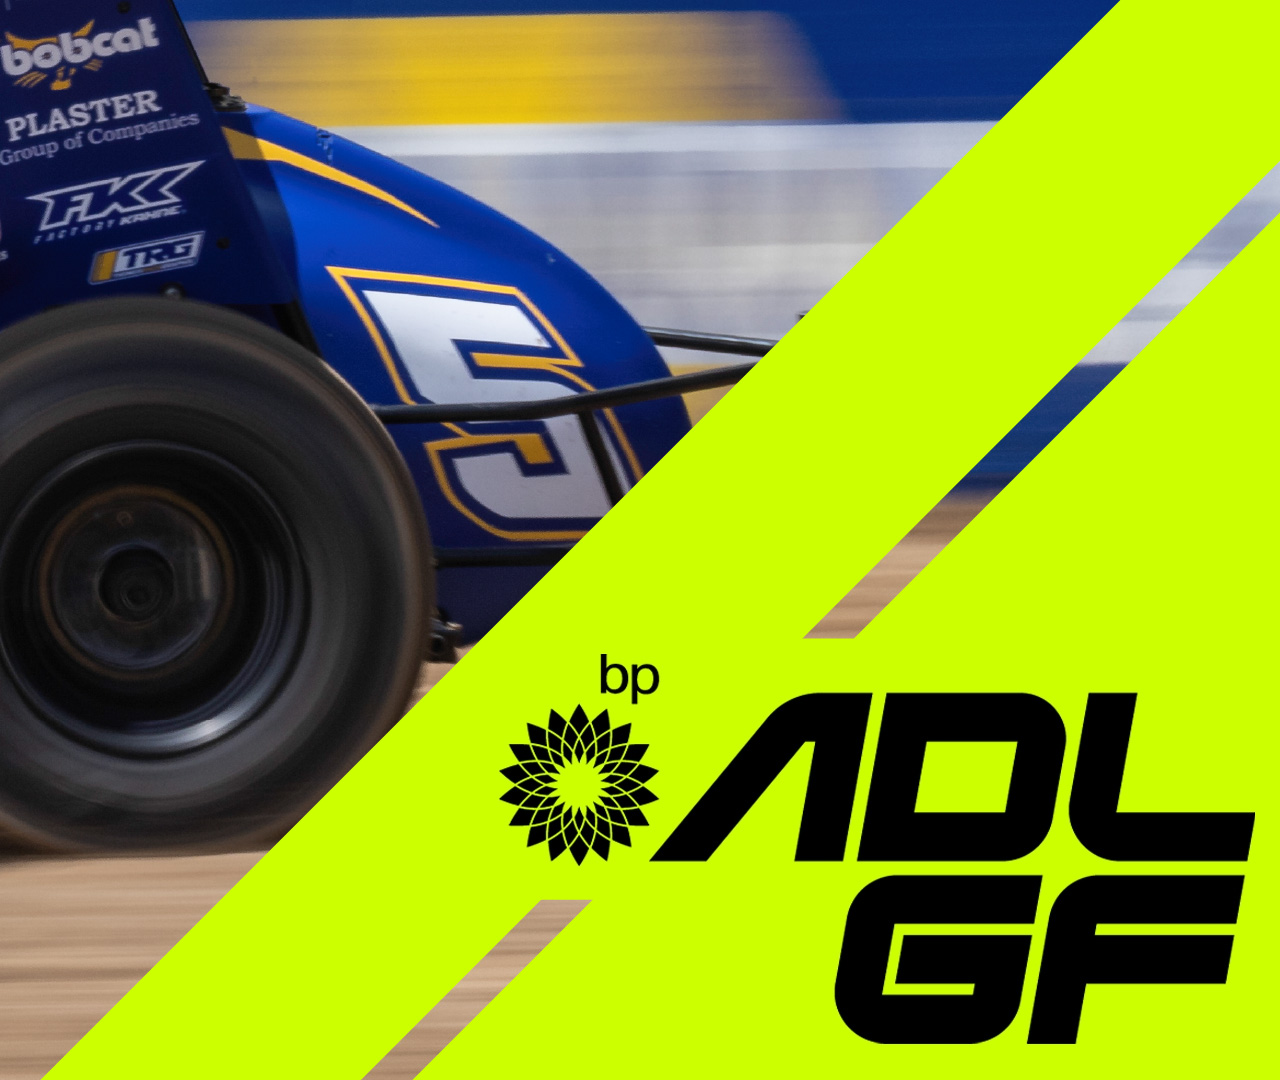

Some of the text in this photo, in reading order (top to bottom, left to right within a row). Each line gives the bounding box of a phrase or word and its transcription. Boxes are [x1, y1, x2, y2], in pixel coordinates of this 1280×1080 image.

[0, 17, 160, 76] bobcat
[5, 89, 162, 143] PLASTER
[63, 127, 85, 148] of
[87, 112, 201, 146] Companies
[361, 290, 632, 519] 5
